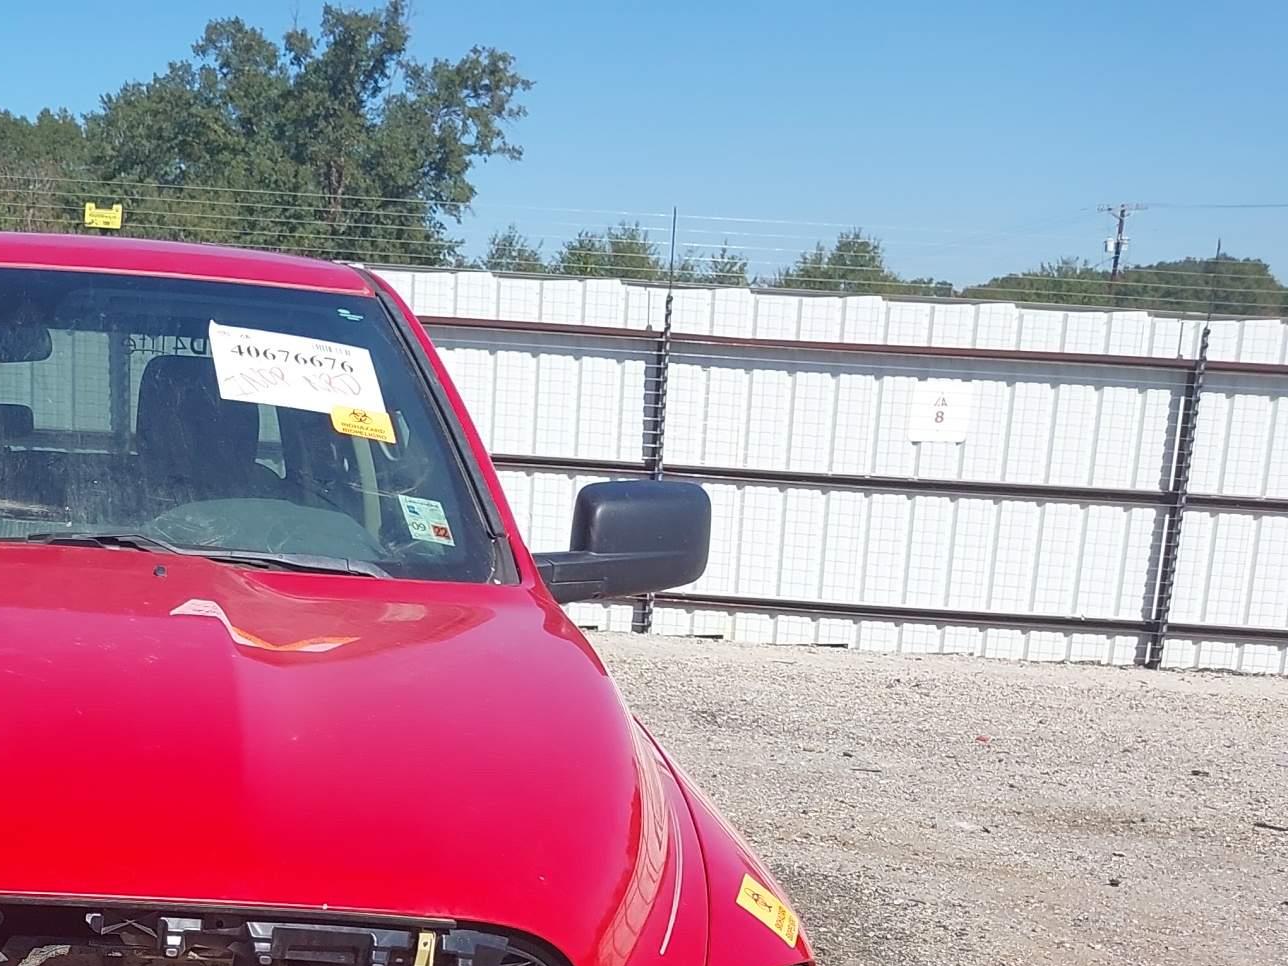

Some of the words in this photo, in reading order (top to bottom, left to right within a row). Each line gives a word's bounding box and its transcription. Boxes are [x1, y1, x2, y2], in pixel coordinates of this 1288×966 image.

[230, 343, 354, 374] 40676676
[934, 410, 944, 424] 8
[412, 521, 427, 532] 09
[433, 526, 450, 538] 22
